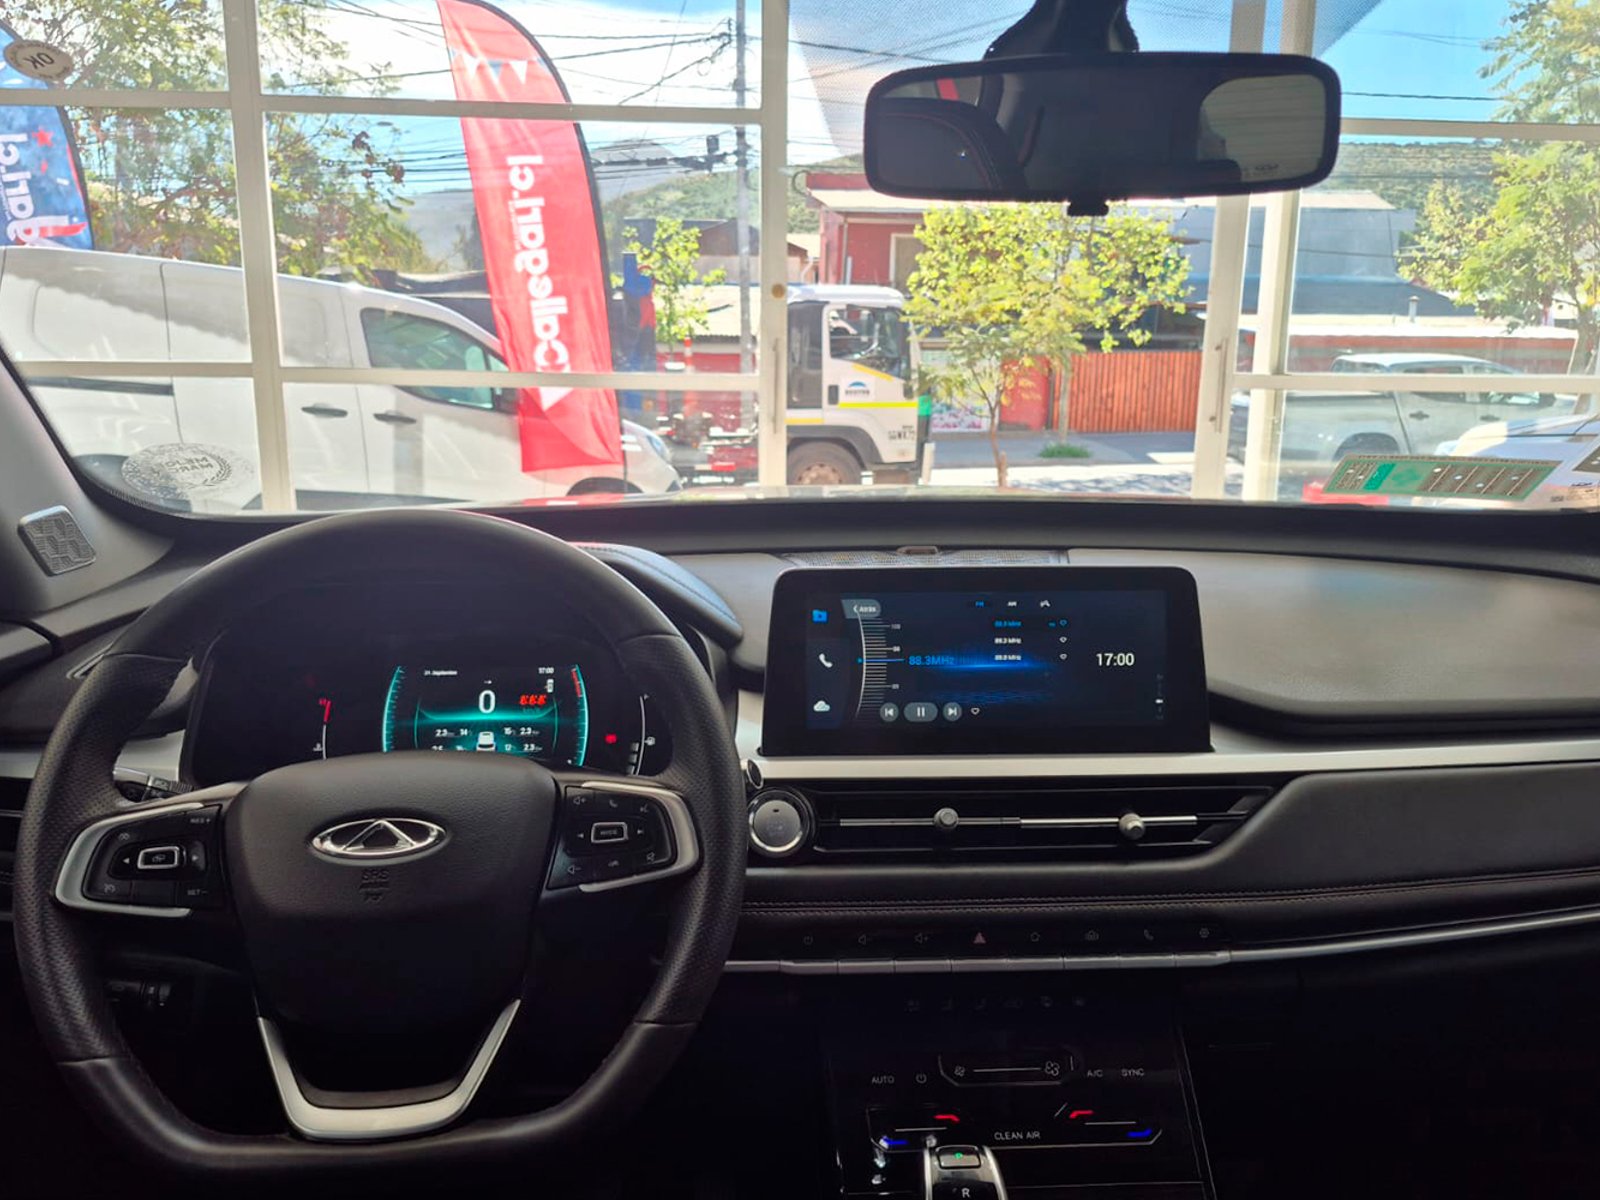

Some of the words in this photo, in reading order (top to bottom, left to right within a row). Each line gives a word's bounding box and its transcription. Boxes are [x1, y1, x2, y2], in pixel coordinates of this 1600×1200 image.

[908, 654, 956, 667] 88.3MHz
[1095, 652, 1135, 667] 17:00
[478, 689, 496, 714] 0
[1087, 1069, 1104, 1078] A/C
[1121, 1068, 1145, 1078] SYNC
[871, 1075, 895, 1085] AUTO
[994, 1131, 1024, 1141] CLEAN
[1025, 1130, 1041, 1140] AIR
[961, 1187, 971, 1198] R
